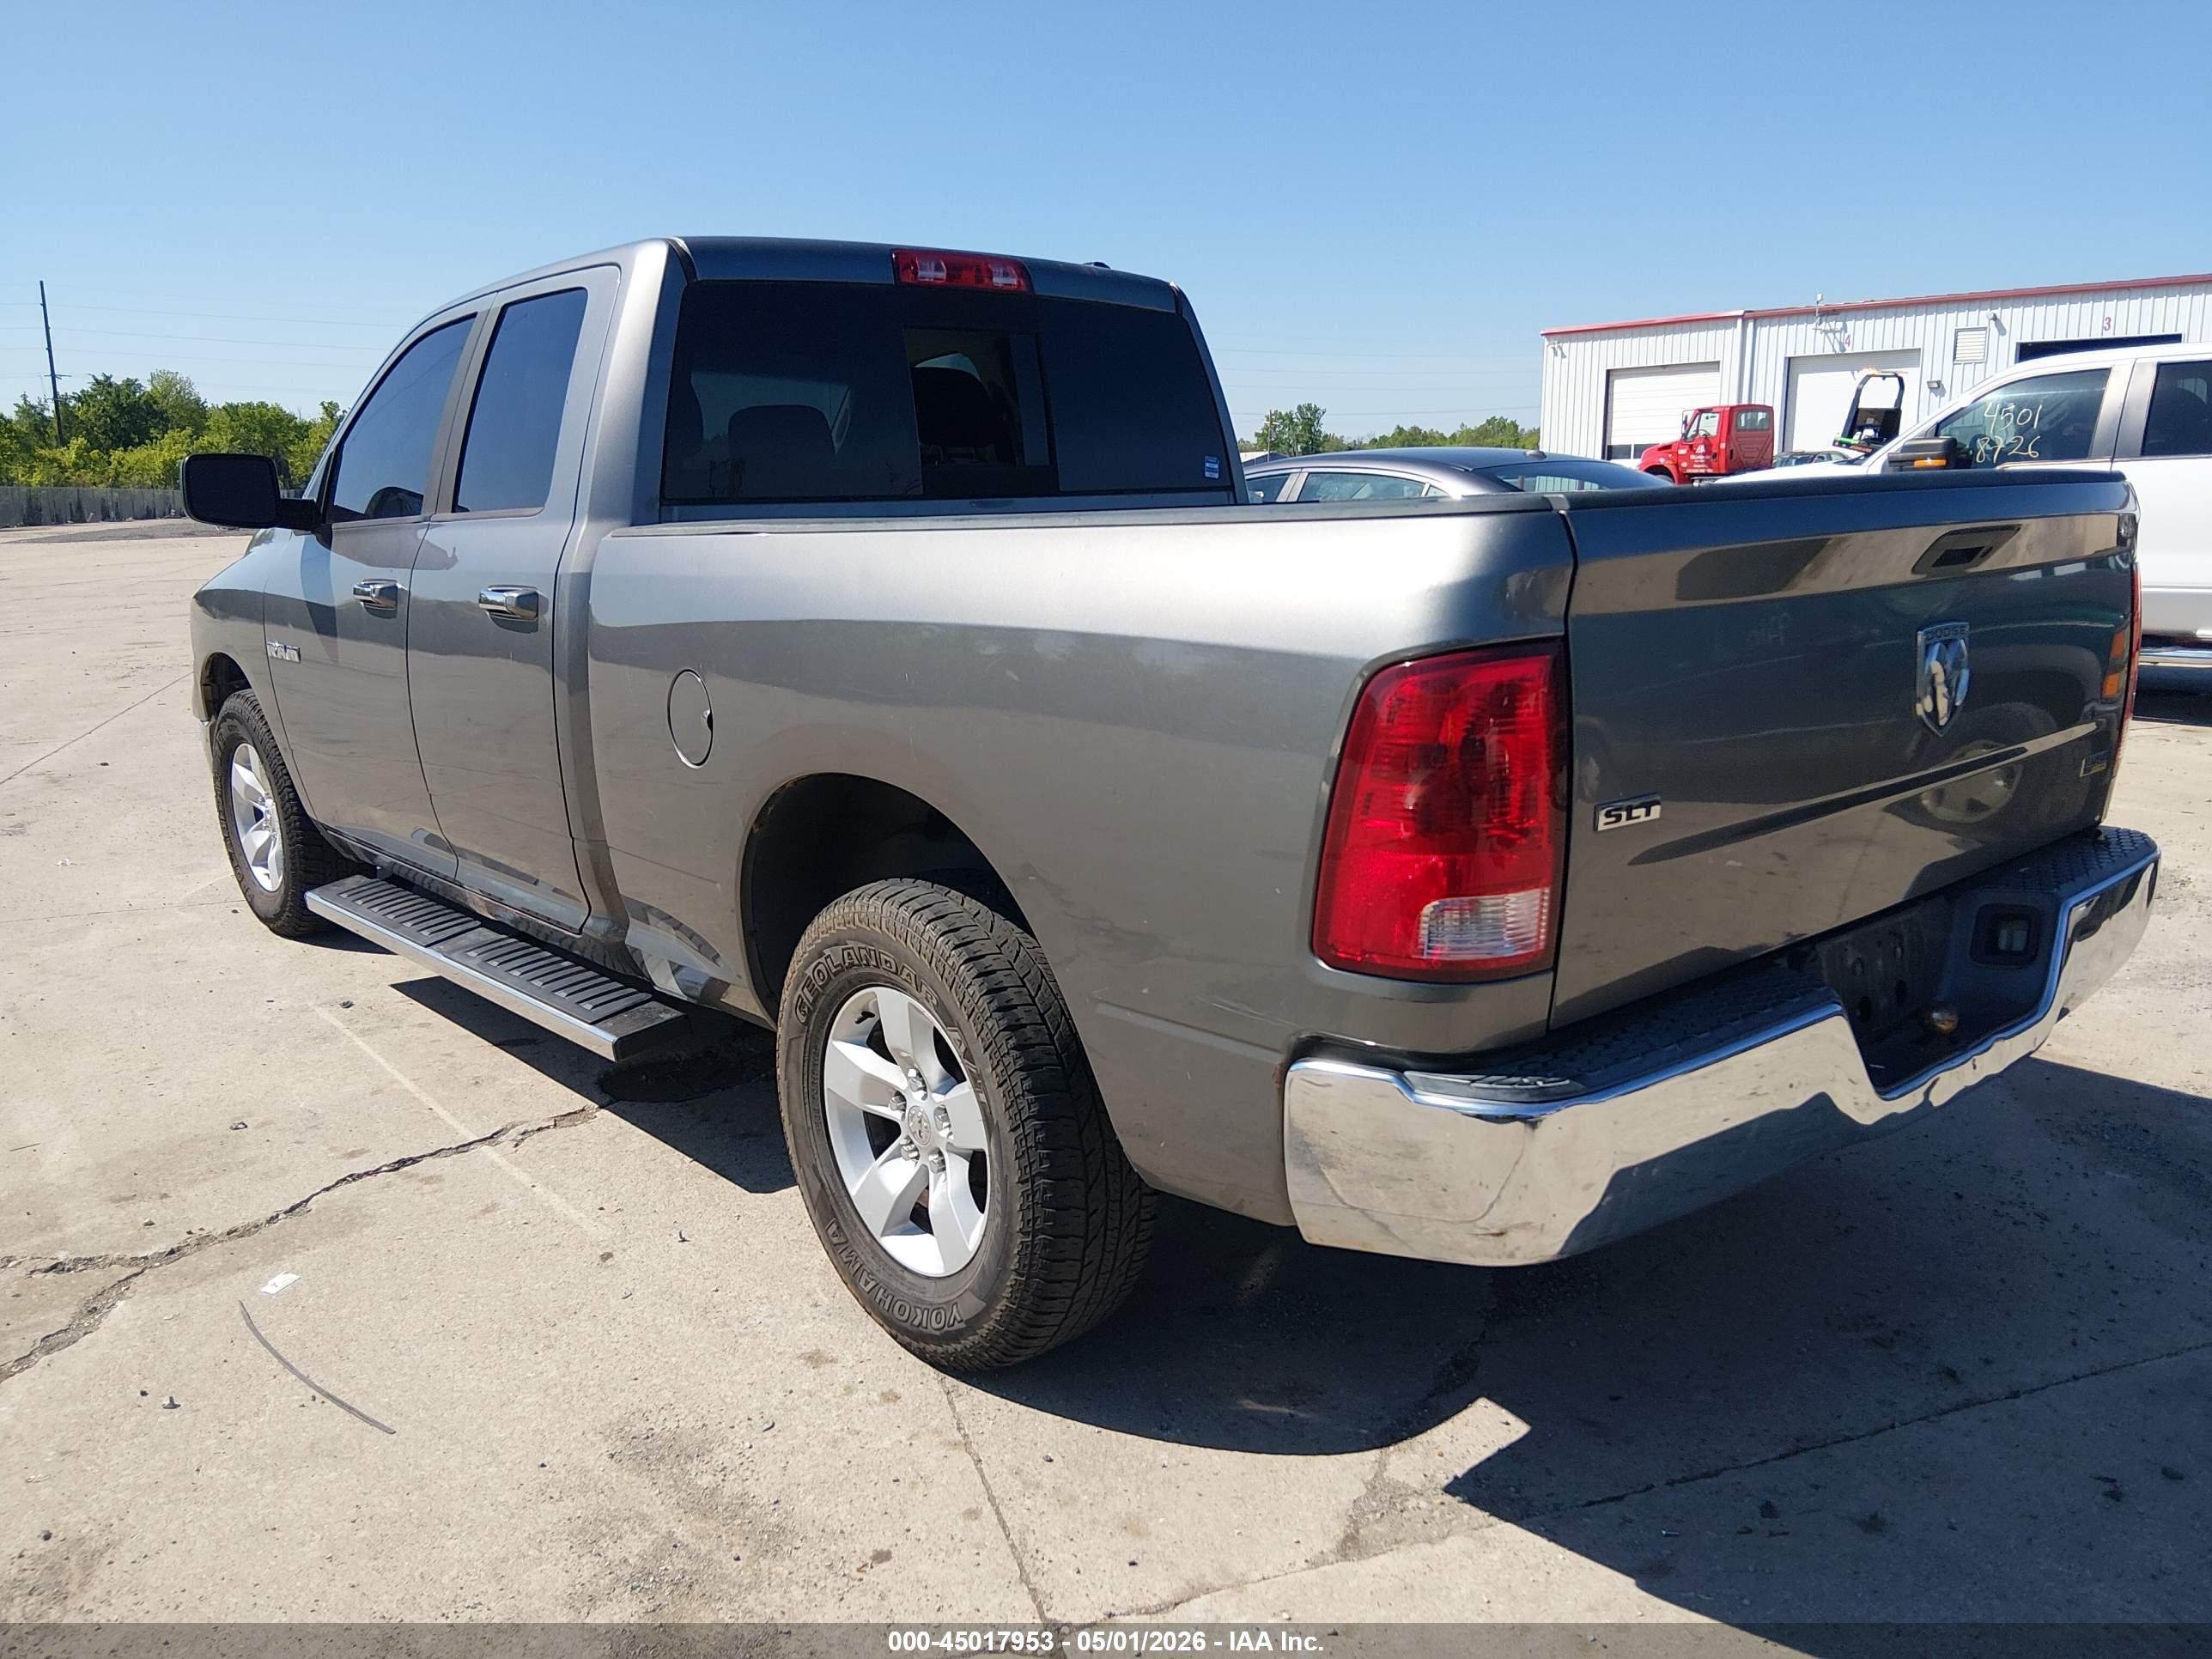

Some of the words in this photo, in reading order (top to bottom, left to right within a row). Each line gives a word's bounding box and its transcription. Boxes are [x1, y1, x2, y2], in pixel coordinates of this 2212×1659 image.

[2104, 316, 2112, 331] 3
[1844, 334, 1851, 347] 4
[1984, 401, 2043, 434] 4501
[1976, 435, 2041, 463] 8726
[1925, 624, 1966, 641] DODGE
[1603, 799, 1661, 826] SLT
[794, 945, 939, 1024] GEOLANDAR
[824, 1218, 965, 1331] YOKOHAMA
